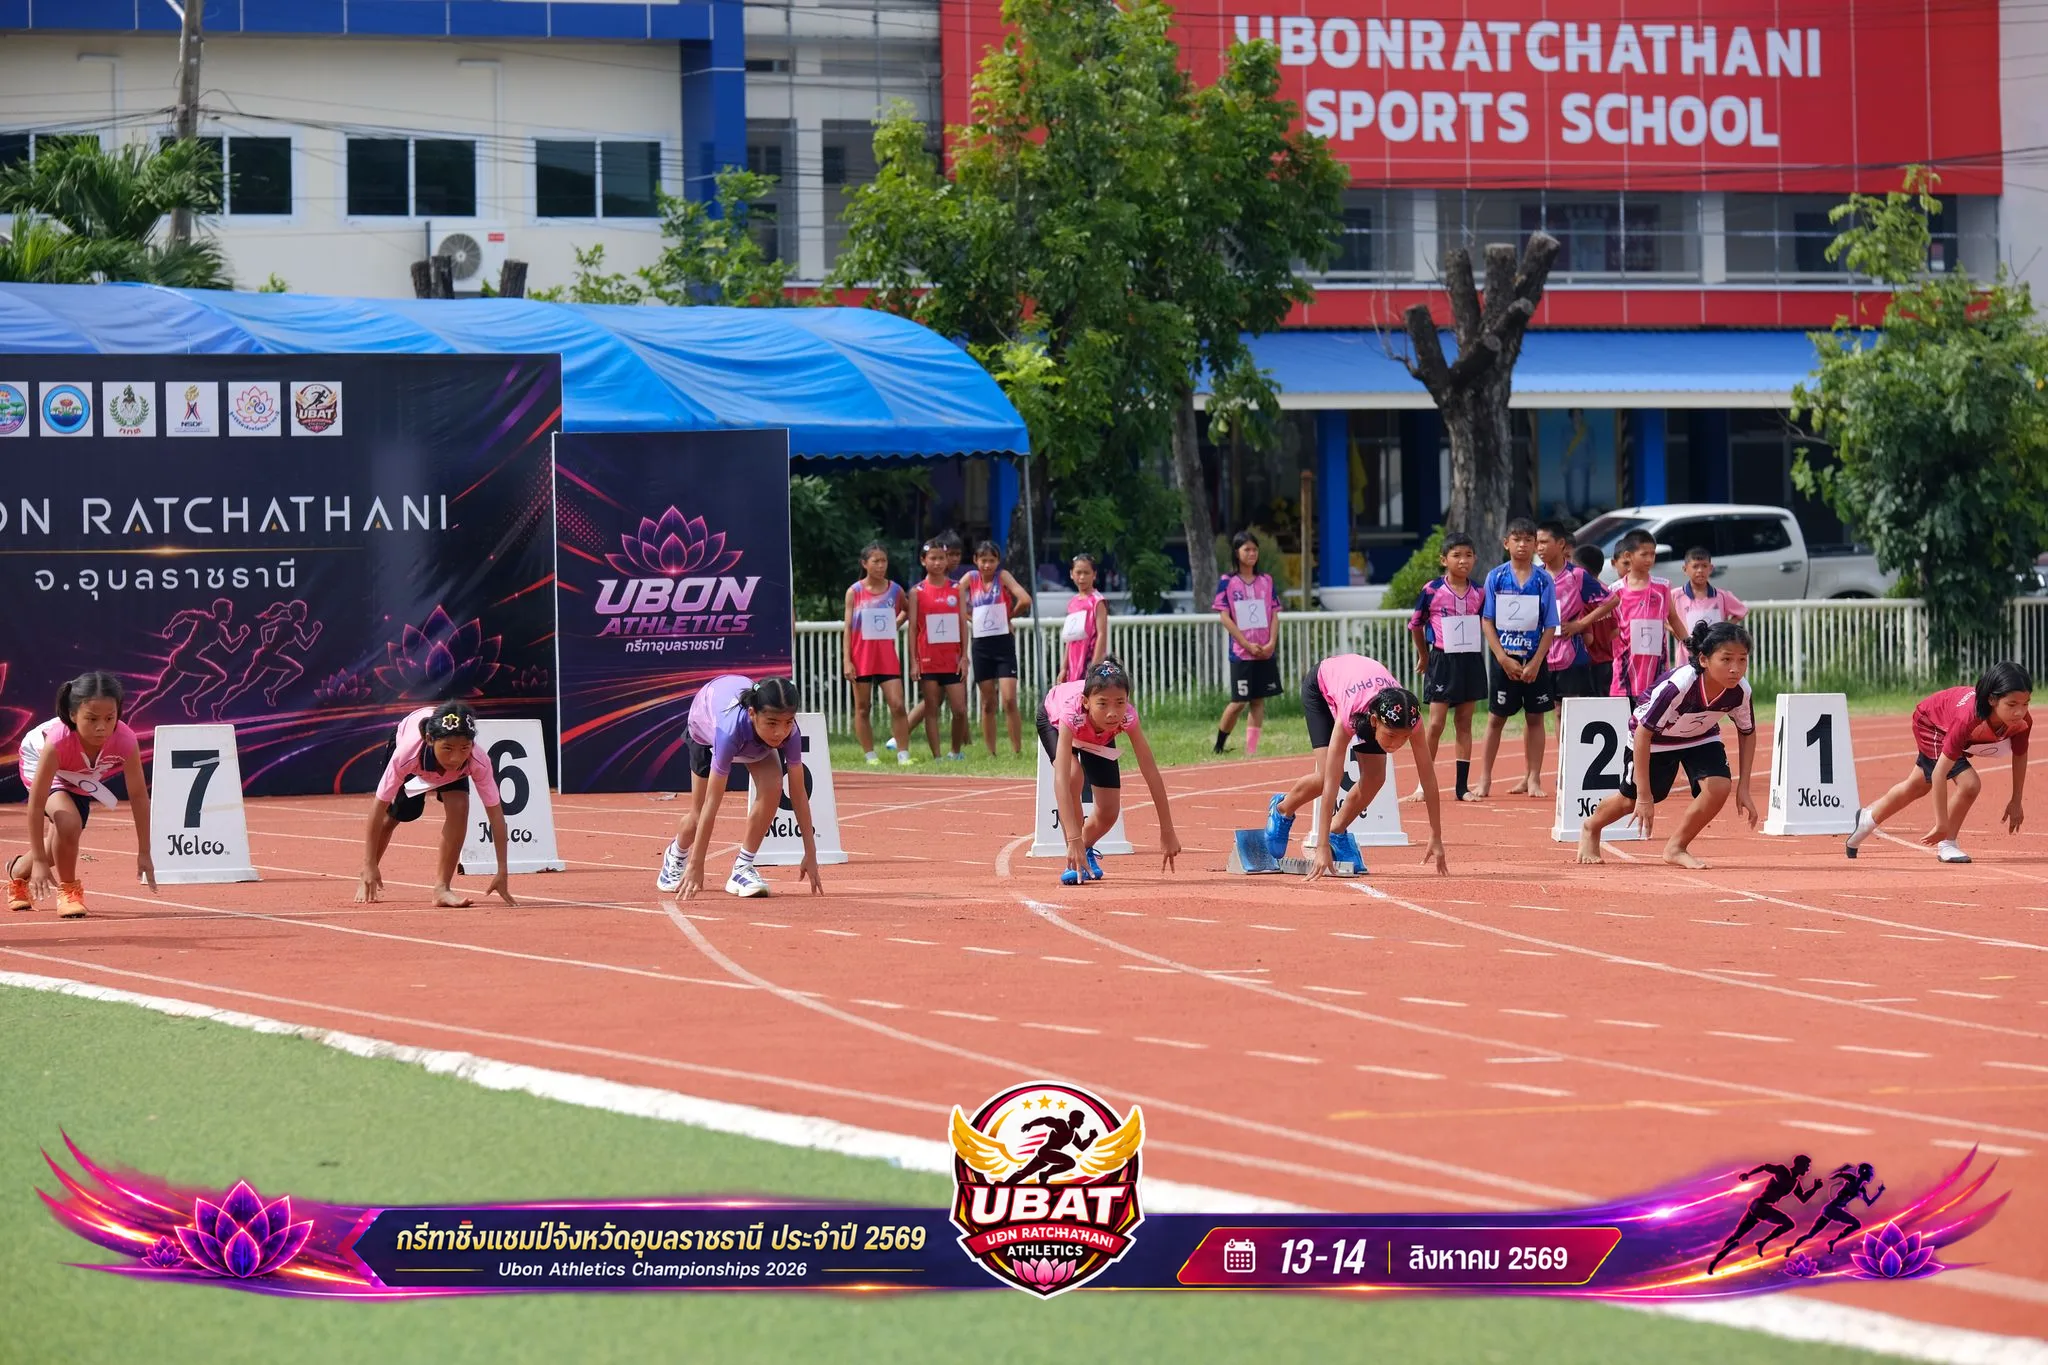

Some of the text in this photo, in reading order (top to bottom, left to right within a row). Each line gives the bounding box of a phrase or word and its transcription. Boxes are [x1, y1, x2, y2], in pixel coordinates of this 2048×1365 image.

[1306, 89, 1779, 147] SPORTS SCHOOL
[300, 409, 334, 419] UBAT
[0, 495, 447, 535] N RATCHATHANI
[35, 558, 296, 600] จ.อุบลราชธานี
[595, 576, 762, 614] UBON
[983, 609, 996, 630] 6
[1248, 603, 1259, 624] 8
[1508, 600, 1524, 620] 2
[596, 614, 754, 637] ATHLETICS
[873, 615, 887, 632] 5
[935, 618, 947, 636] 4
[1454, 621, 1472, 646] 1
[1500, 631, 1532, 650] Chang
[1641, 626, 1653, 648] 5
[1237, 680, 1248, 696] 5
[1497, 691, 1506, 704] 5
[1580, 721, 1620, 790] 2
[1806, 714, 1833, 784] 1
[487, 740, 530, 815] 6
[171, 750, 220, 828] 7
[1798, 788, 1840, 807] Nelco
[765, 817, 815, 838] Nelc
[168, 834, 224, 855] Nelco
